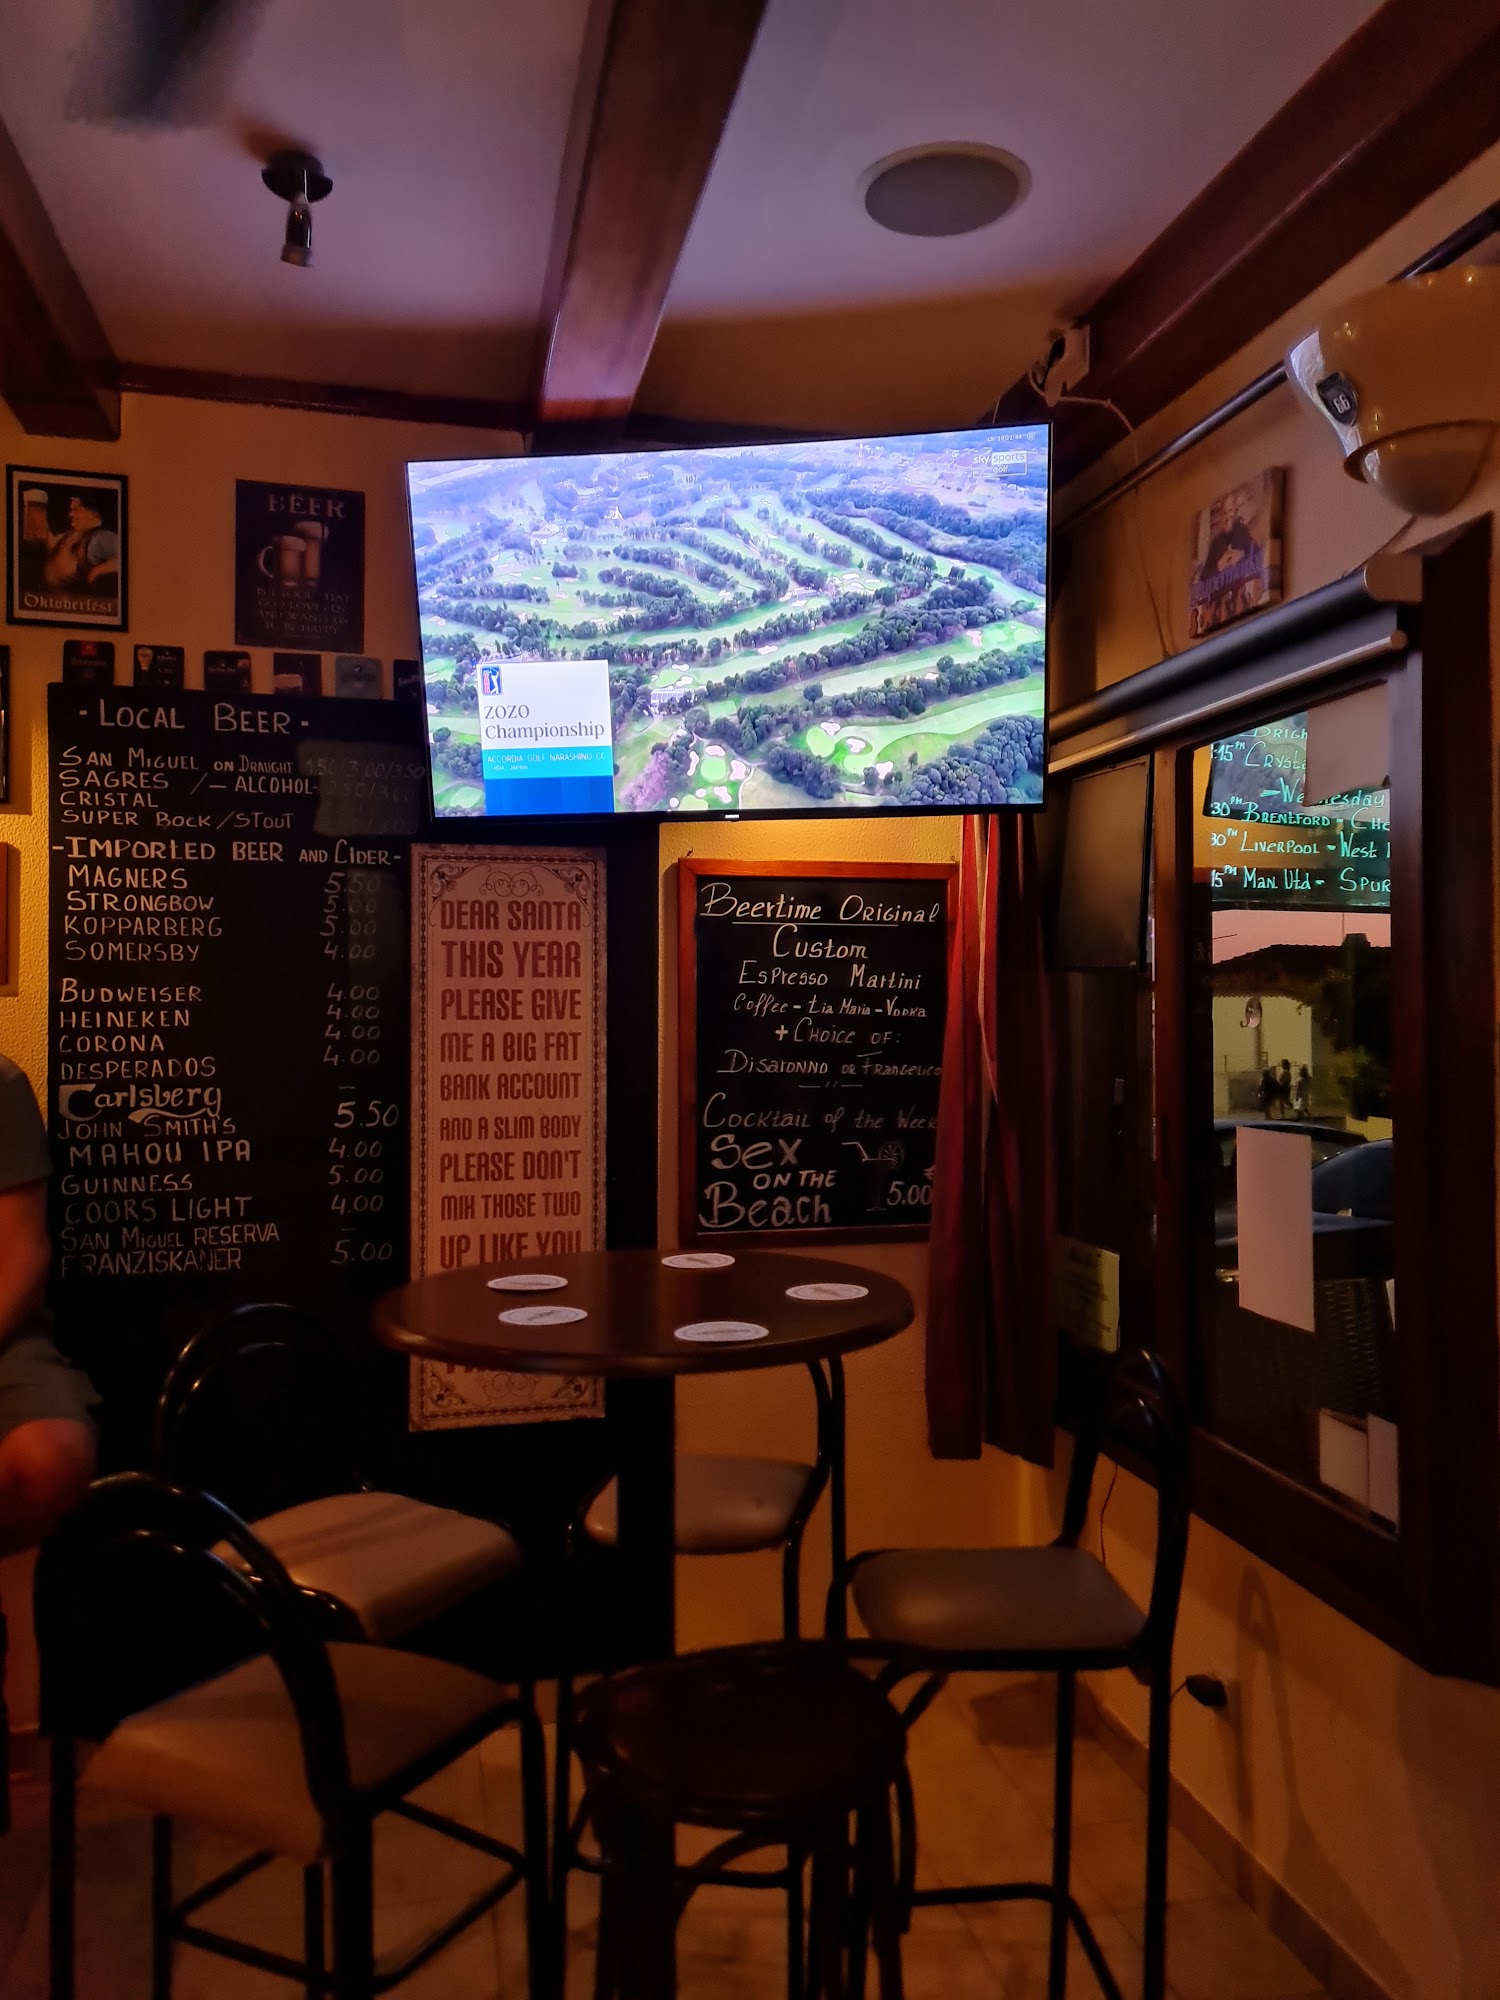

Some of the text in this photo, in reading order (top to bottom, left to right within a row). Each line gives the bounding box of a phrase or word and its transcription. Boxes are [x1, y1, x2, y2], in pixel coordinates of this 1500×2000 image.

[974, 453, 1025, 464] sky sports
[992, 465, 1009, 473] golf
[267, 493, 346, 518] BEER
[24, 592, 113, 612] Oktoberfest
[484, 705, 530, 719] ZOZO
[485, 721, 604, 741] Championship
[487, 755, 523, 763] ACCORDIA
[527, 754, 545, 762] GOLF
[60, 791, 158, 808] CRISTAL
[60, 809, 139, 826] SUPER
[232, 841, 284, 862] BEER
[68, 865, 188, 889] MAGNERS
[67, 891, 214, 912] STRONGBOW
[700, 882, 822, 921] Beertime
[64, 916, 223, 937] KOPPARBERG
[441, 900, 581, 930] DEAR SANTA
[65, 941, 200, 961] SOMERSBY
[441, 941, 581, 978] THIS YEAR
[850, 963, 921, 990] Martini
[60, 977, 202, 1003] BUDWEISER
[441, 988, 581, 1021] PLEASE GIVE
[733, 993, 788, 1016] Coffee
[60, 1009, 190, 1028] HEINEKEN
[59, 1034, 165, 1053] CORONA
[440, 1031, 581, 1063] ME A BIG FAT
[61, 1056, 216, 1081] DESPERADOS
[441, 1072, 581, 1101] BANK ACCOUNT
[58, 1084, 222, 1123] Carlsberg
[333, 1100, 400, 1129] 5.50
[440, 1114, 581, 1141] AND A SLIM BODY
[824, 1112, 842, 1133] of
[854, 1108, 884, 1129] the
[69, 1139, 251, 1168] MAHOU IPA
[327, 1137, 383, 1158] 4.00
[711, 1133, 803, 1170] Sex
[328, 1165, 384, 1184] 5.00
[440, 1150, 581, 1183] PLEASE DON'T
[799, 1169, 838, 1188] THE
[61, 1174, 193, 1195] GUINNESS
[64, 1196, 253, 1226] COORS LIGHT
[330, 1194, 384, 1215] 4.00
[441, 1192, 581, 1220] MIX THOSE TWO
[698, 1182, 832, 1229] Beach
[194, 1222, 280, 1246] RESERVA
[330, 1239, 393, 1265] 5.00
[439, 1230, 581, 1270] UP LIKE YOU
